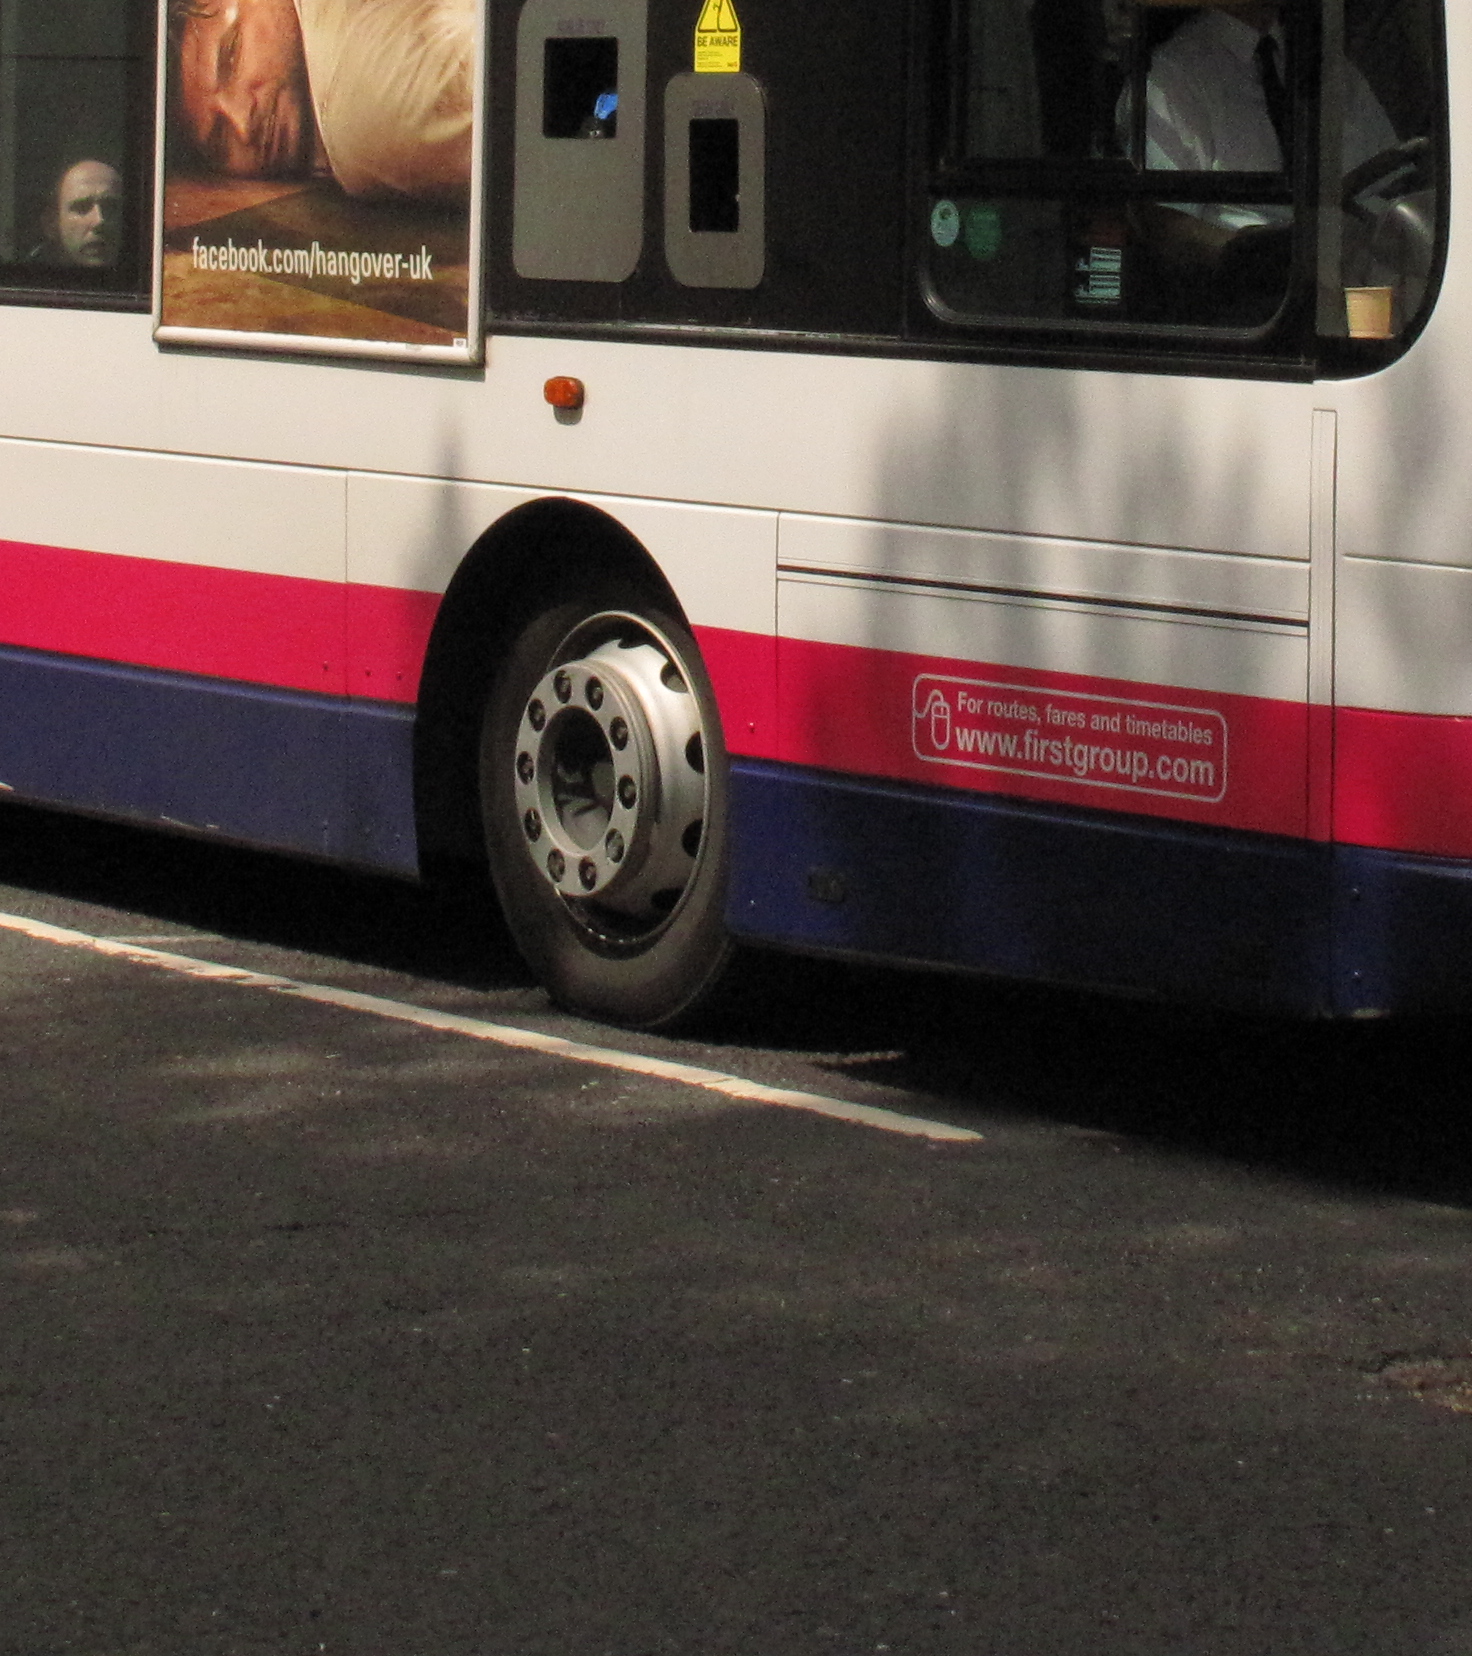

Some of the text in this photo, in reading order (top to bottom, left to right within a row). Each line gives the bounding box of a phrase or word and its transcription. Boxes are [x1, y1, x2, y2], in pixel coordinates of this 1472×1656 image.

[697, 35, 738, 47] BE AWARE
[192, 237, 433, 285] facebook.com/hangover-uk
[956, 691, 1213, 746] For routes, fares and timetables
[955, 725, 1216, 788] www.firstgroup.com
